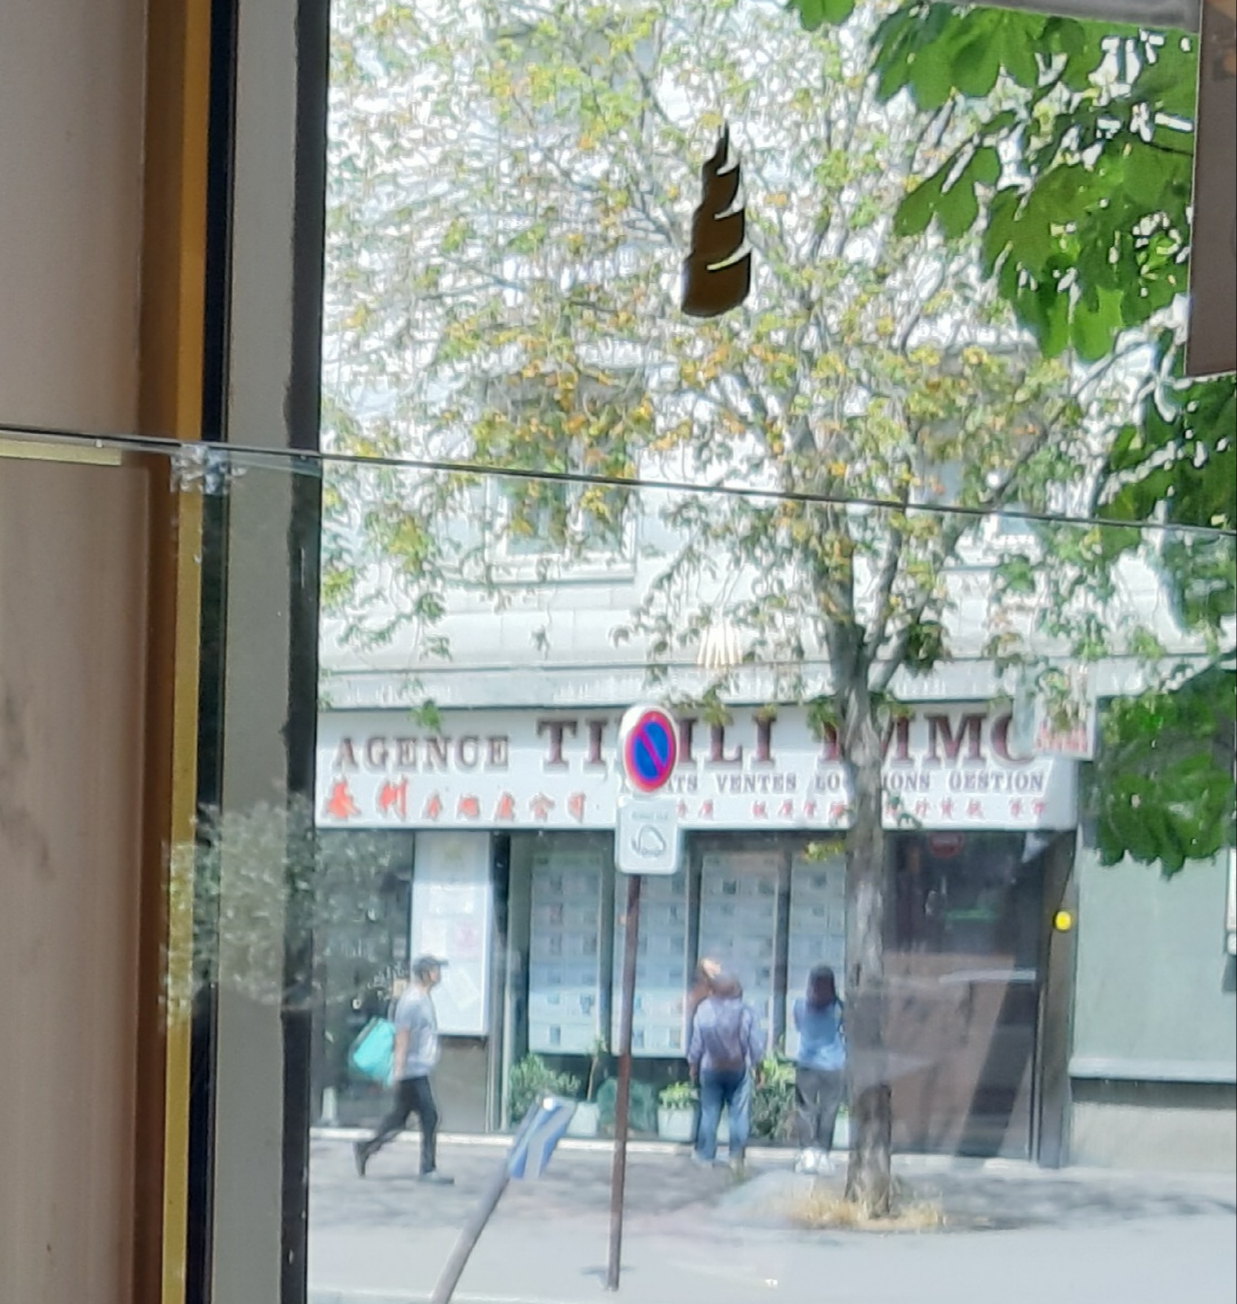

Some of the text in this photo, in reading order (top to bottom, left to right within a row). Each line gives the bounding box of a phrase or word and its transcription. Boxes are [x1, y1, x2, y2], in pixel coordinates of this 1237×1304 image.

[332, 735, 510, 770] AGENCE
[716, 771, 797, 794] VENTES
[948, 768, 1046, 793] GESTION
